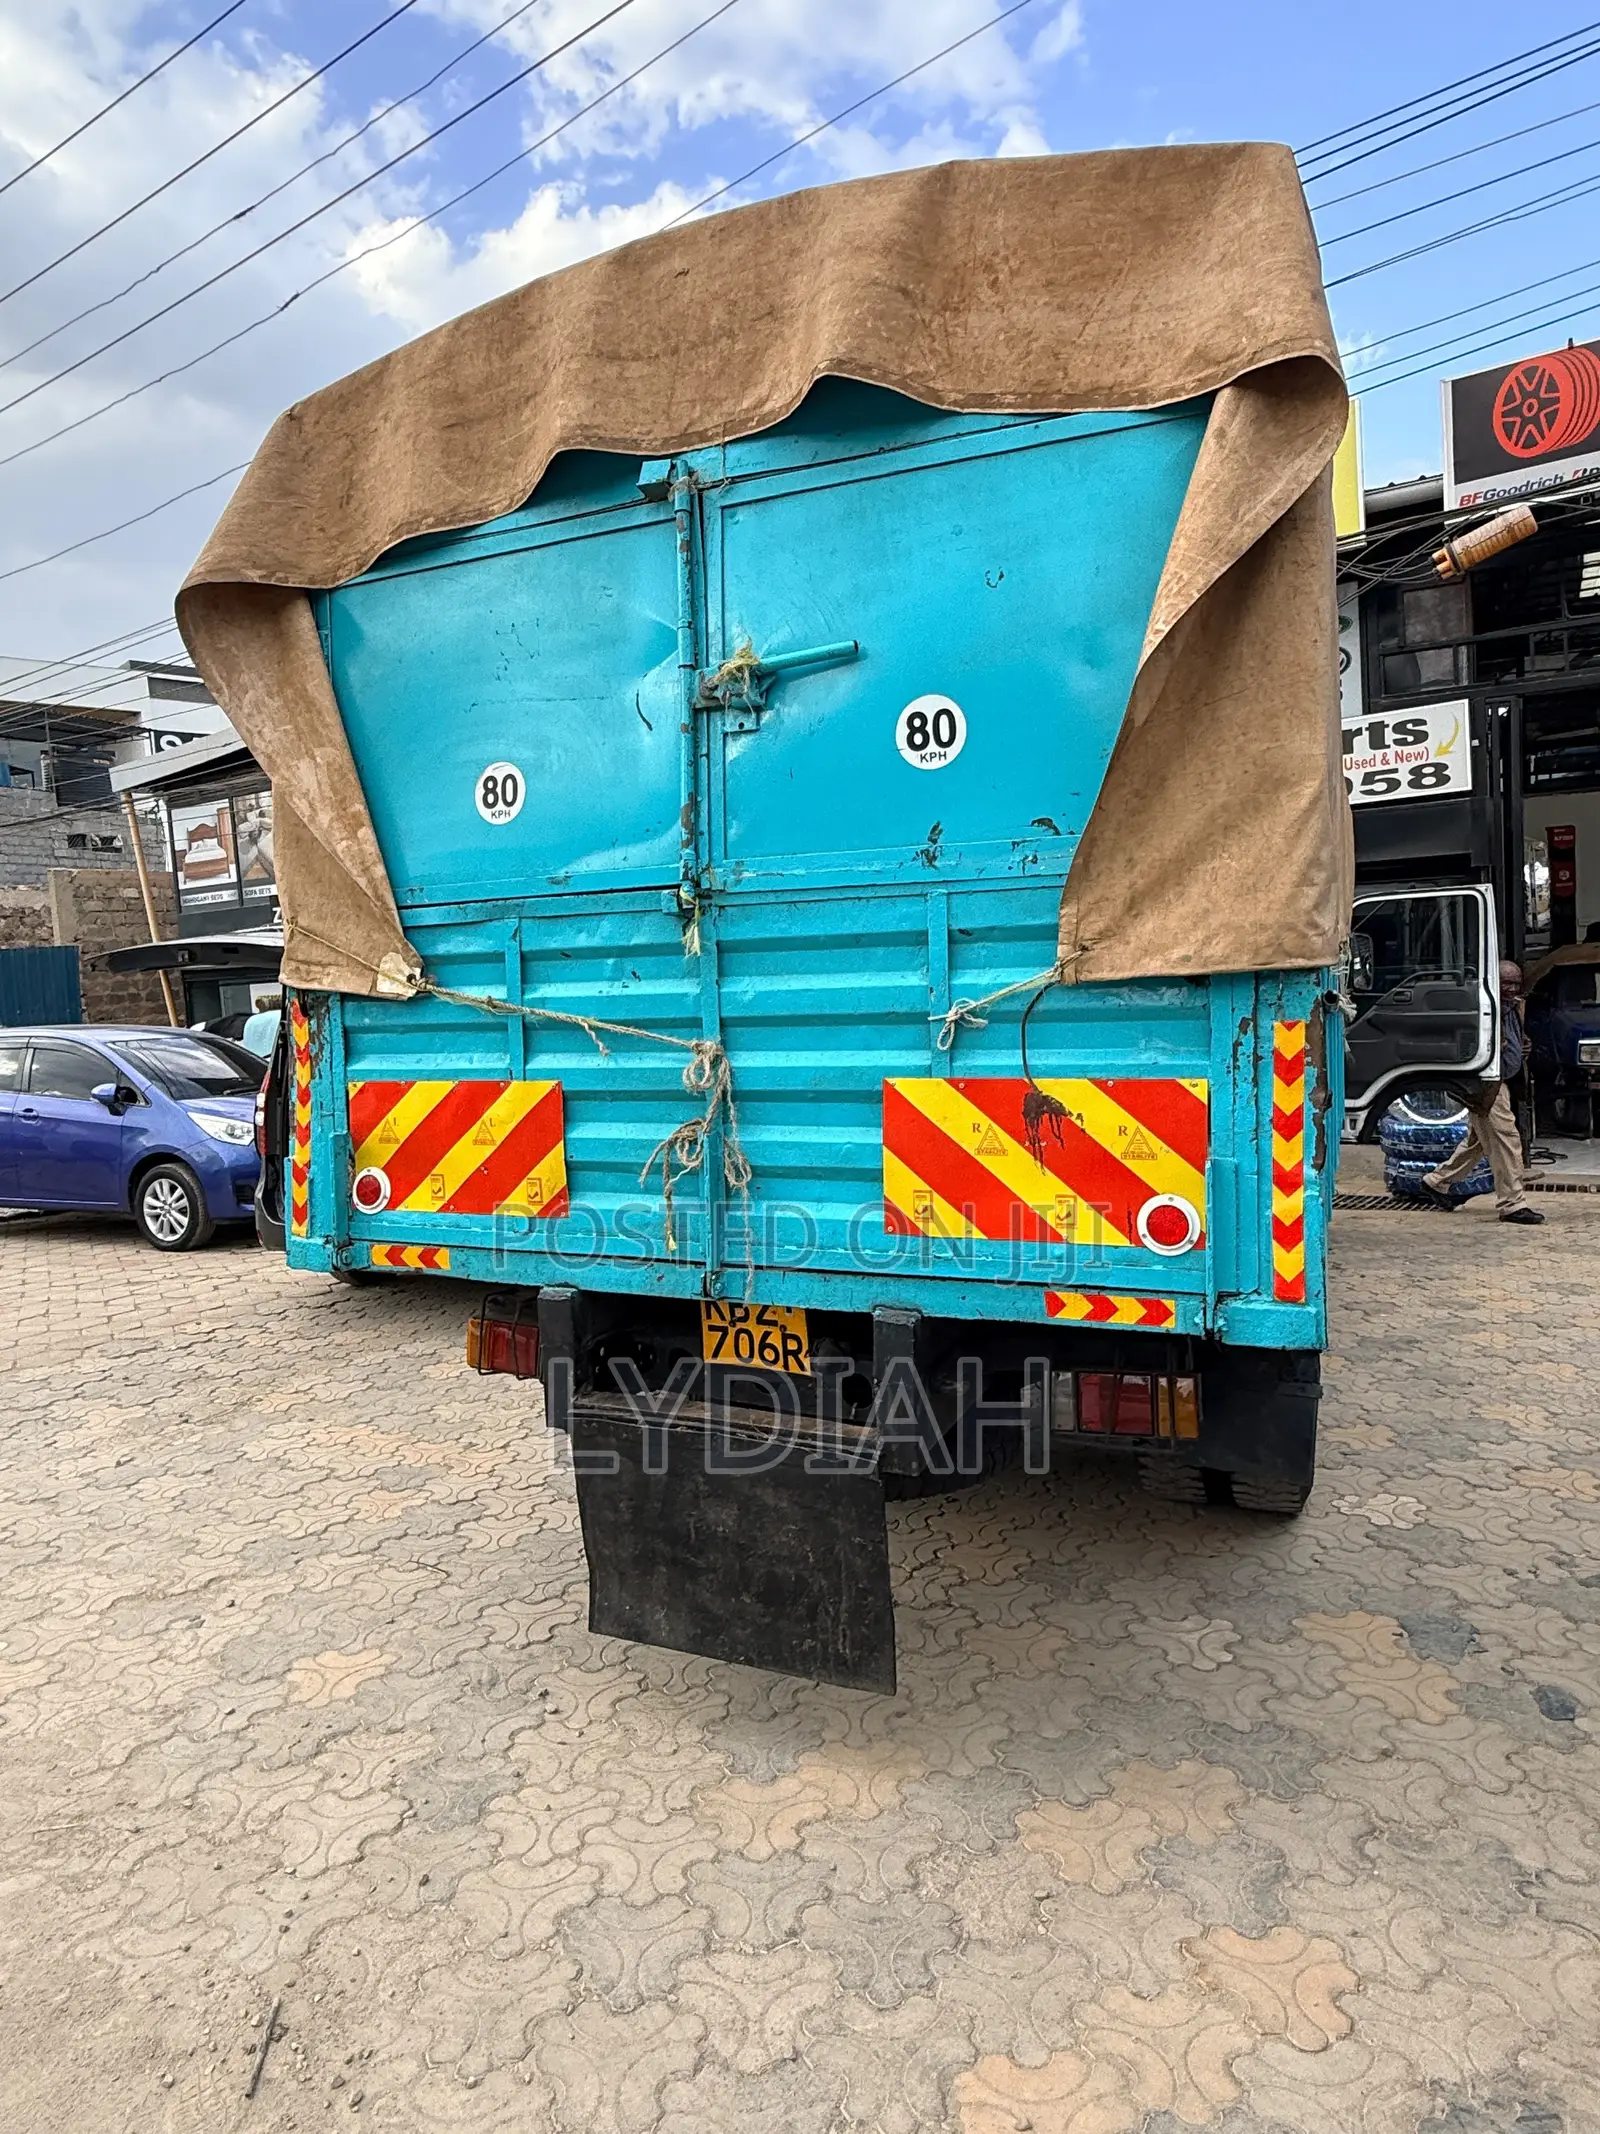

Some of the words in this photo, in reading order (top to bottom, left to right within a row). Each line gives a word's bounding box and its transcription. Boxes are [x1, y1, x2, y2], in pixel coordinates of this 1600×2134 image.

[1459, 474, 1564, 507] BFGoodrich
[906, 708, 957, 751] 80
[919, 751, 947, 763] KPH
[1381, 752, 1390, 766] &
[1394, 746, 1429, 764] New)
[482, 773, 518, 810] 80
[491, 809, 511, 819] KPH
[244, 889, 258, 897] SOFA
[1118, 1125, 1129, 1136] R
[707, 1324, 807, 1372] 706R
